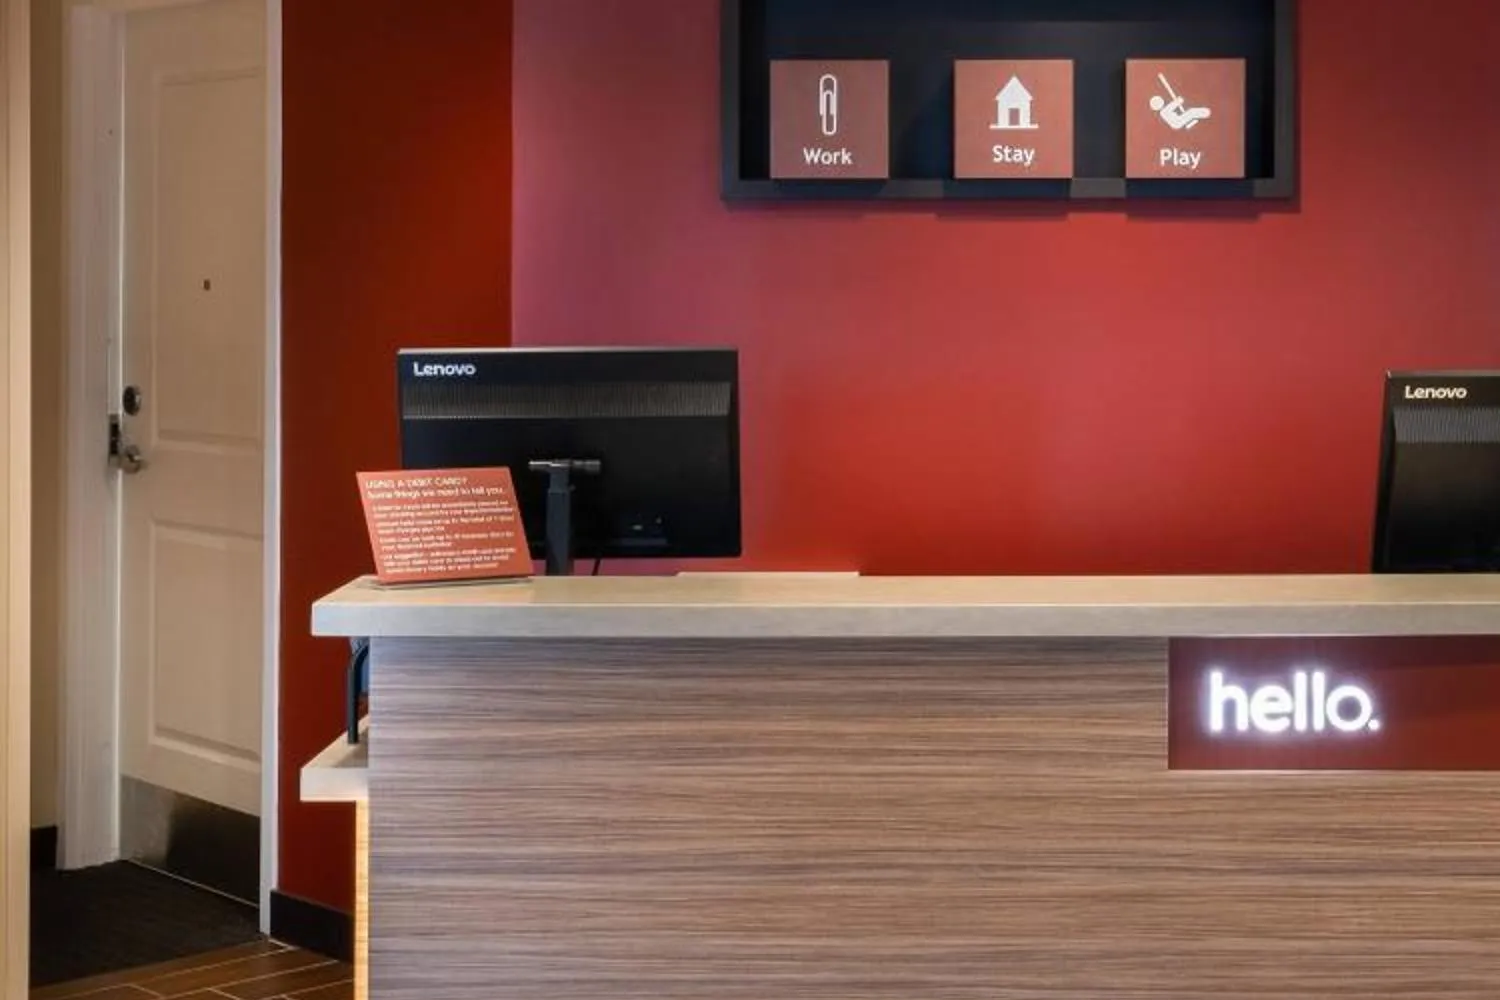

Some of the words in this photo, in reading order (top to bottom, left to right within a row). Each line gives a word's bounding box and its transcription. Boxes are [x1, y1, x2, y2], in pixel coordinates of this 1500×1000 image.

[802, 147, 854, 165] Work
[991, 145, 1036, 166] Stay
[1159, 149, 1202, 169] Play
[413, 361, 477, 377] Lenovo
[1405, 385, 1468, 399] Lenovo
[1210, 670, 1380, 732] hello.
